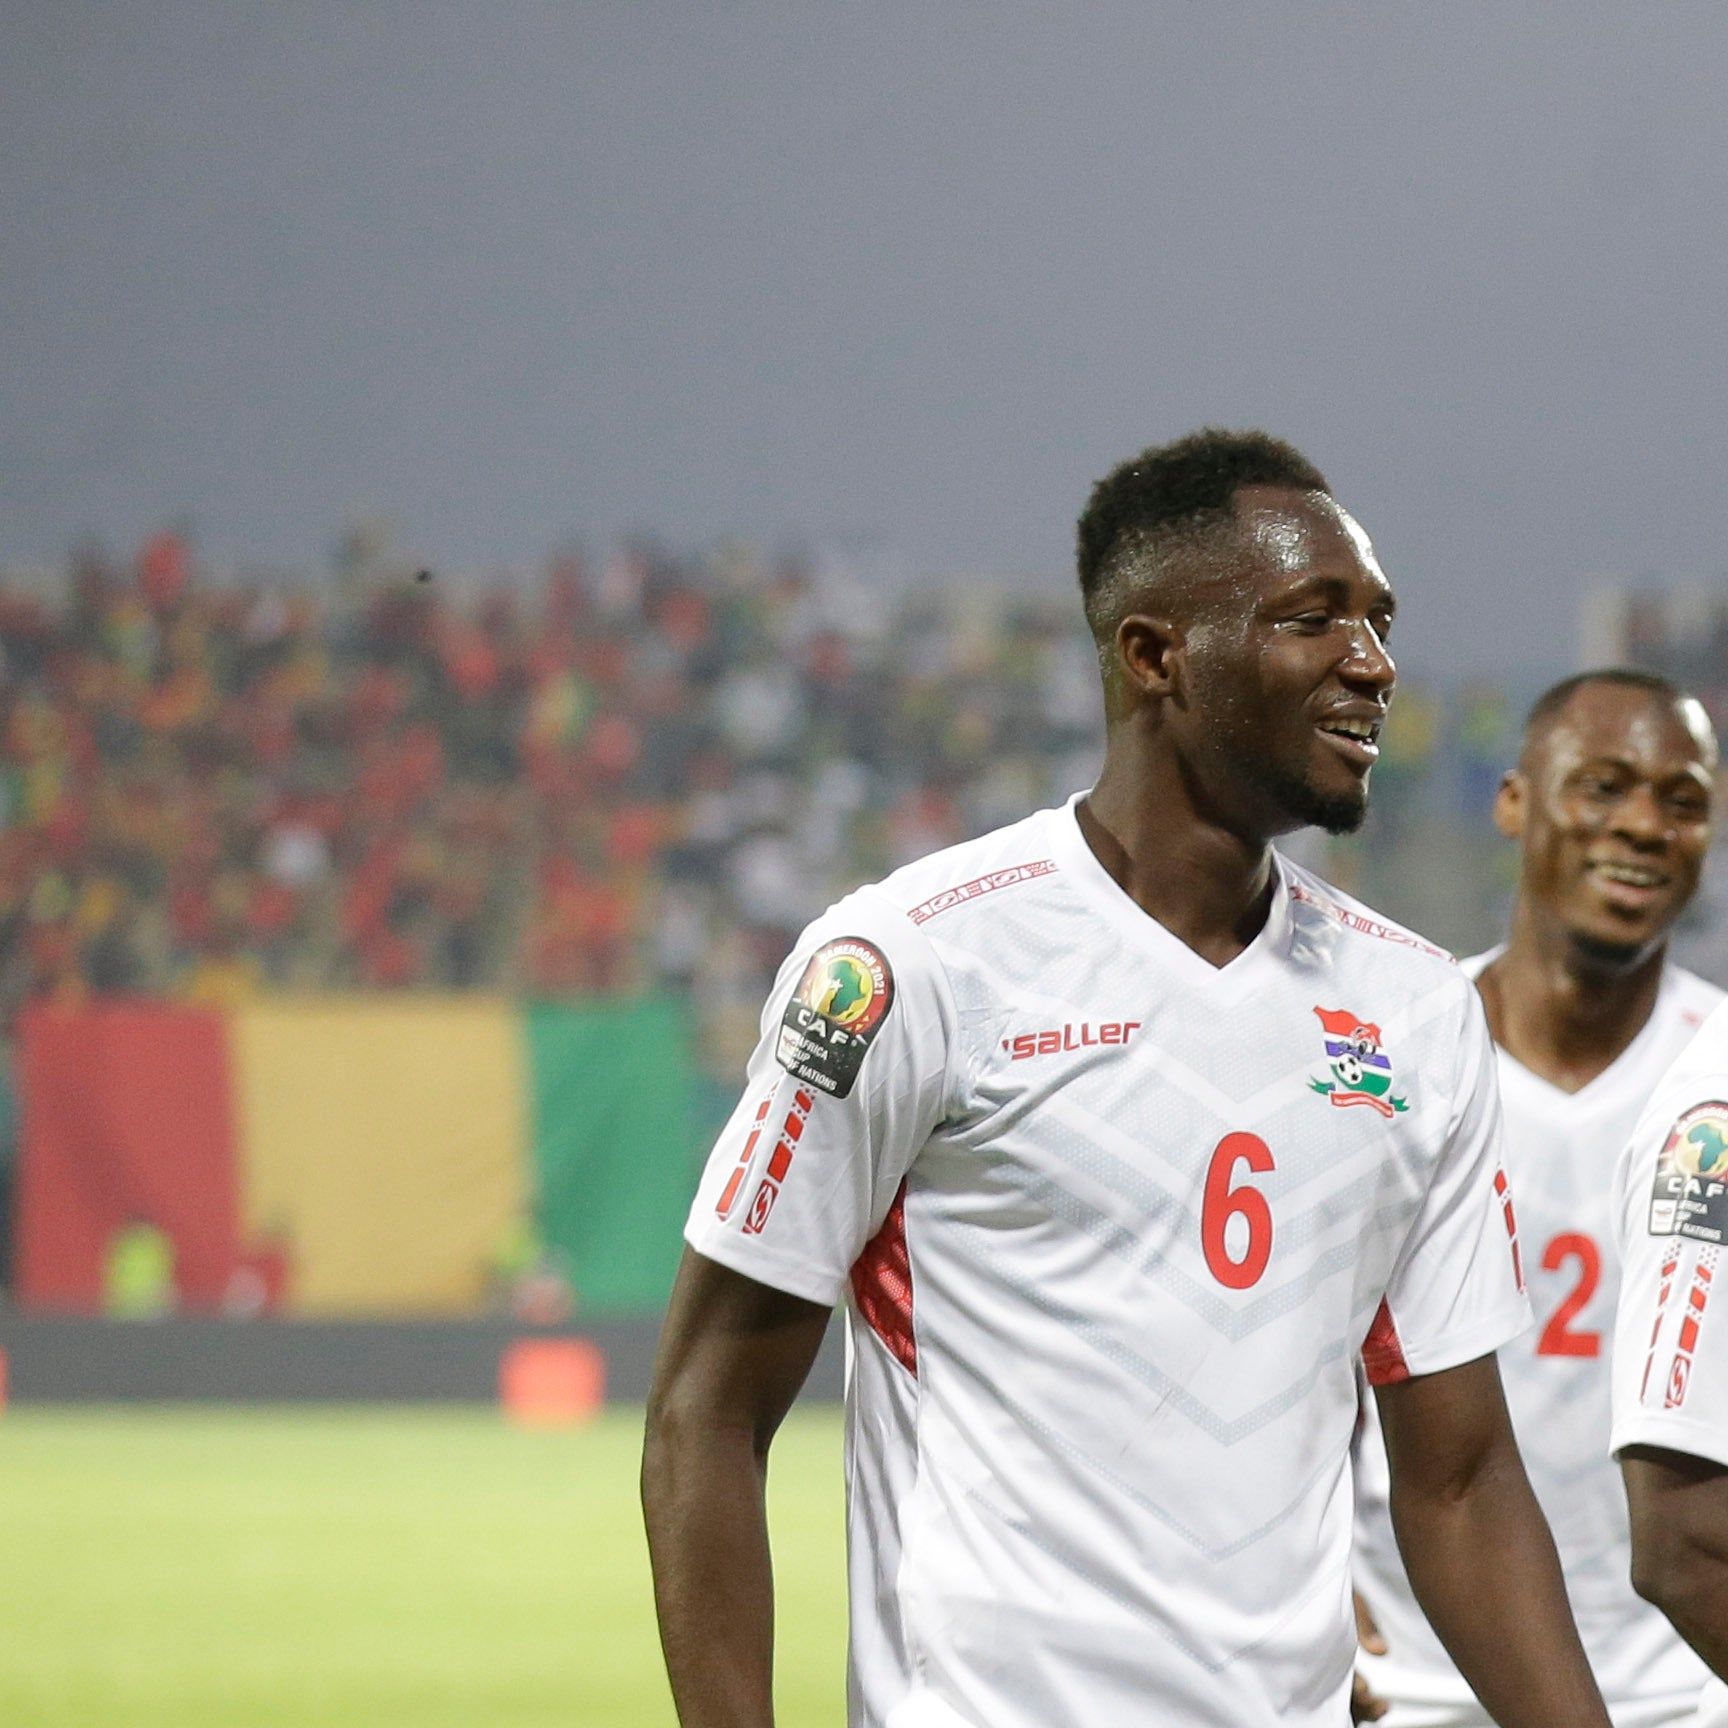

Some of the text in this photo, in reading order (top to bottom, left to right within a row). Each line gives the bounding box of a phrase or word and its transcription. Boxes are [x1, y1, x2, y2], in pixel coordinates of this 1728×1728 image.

[870, 965, 885, 995] 2021
[797, 1008, 849, 1045] CAF
[798, 1065, 838, 1091] NATIONS
[1201, 1132, 1274, 1290] 6
[1537, 1232, 1599, 1357] 2
